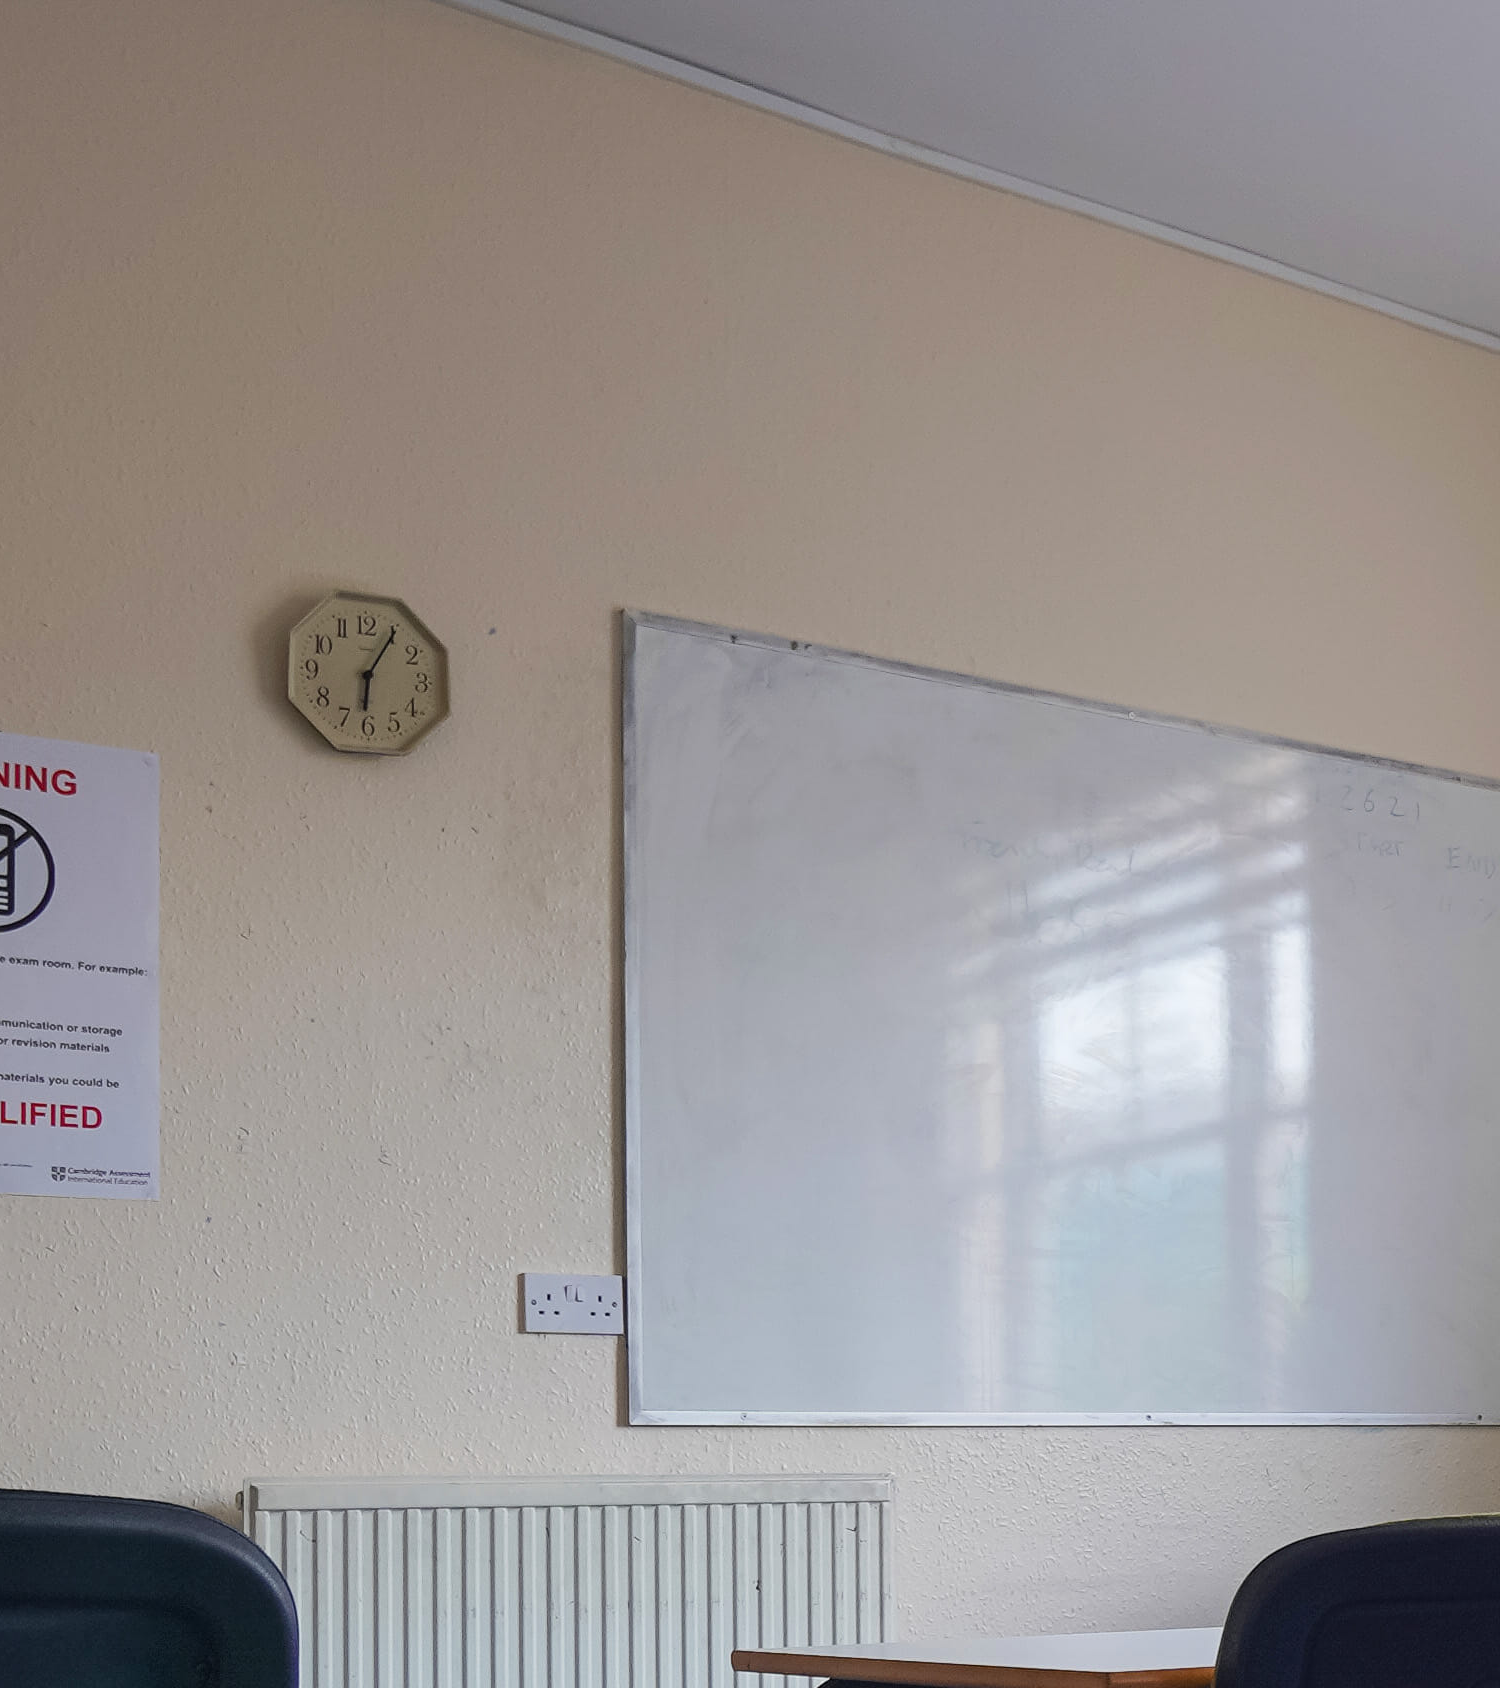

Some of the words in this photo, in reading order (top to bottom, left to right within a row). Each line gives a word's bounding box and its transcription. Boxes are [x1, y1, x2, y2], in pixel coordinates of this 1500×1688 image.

[337, 618, 348, 638] 11
[357, 615, 377, 636] 12
[315, 634, 333, 655] 10
[405, 645, 419, 665] 2
[305, 659, 319, 680] 9
[415, 672, 429, 693] 3
[317, 686, 330, 708] 8
[405, 697, 417, 717] 4
[339, 707, 350, 727] 7
[361, 715, 375, 736] 6
[388, 712, 400, 732] 5
[9, 957, 39, 967] exam
[43, 960, 74, 970] room.
[78, 962, 96, 972] For
[99, 966, 148, 977] example:
[67, 1024, 78, 1033] or
[81, 1026, 123, 1037] storage
[11, 1038, 56, 1049] revision
[60, 1042, 110, 1053] materials
[48, 1077, 69, 1086] you
[72, 1078, 103, 1087] could
[106, 1079, 120, 1088] be
